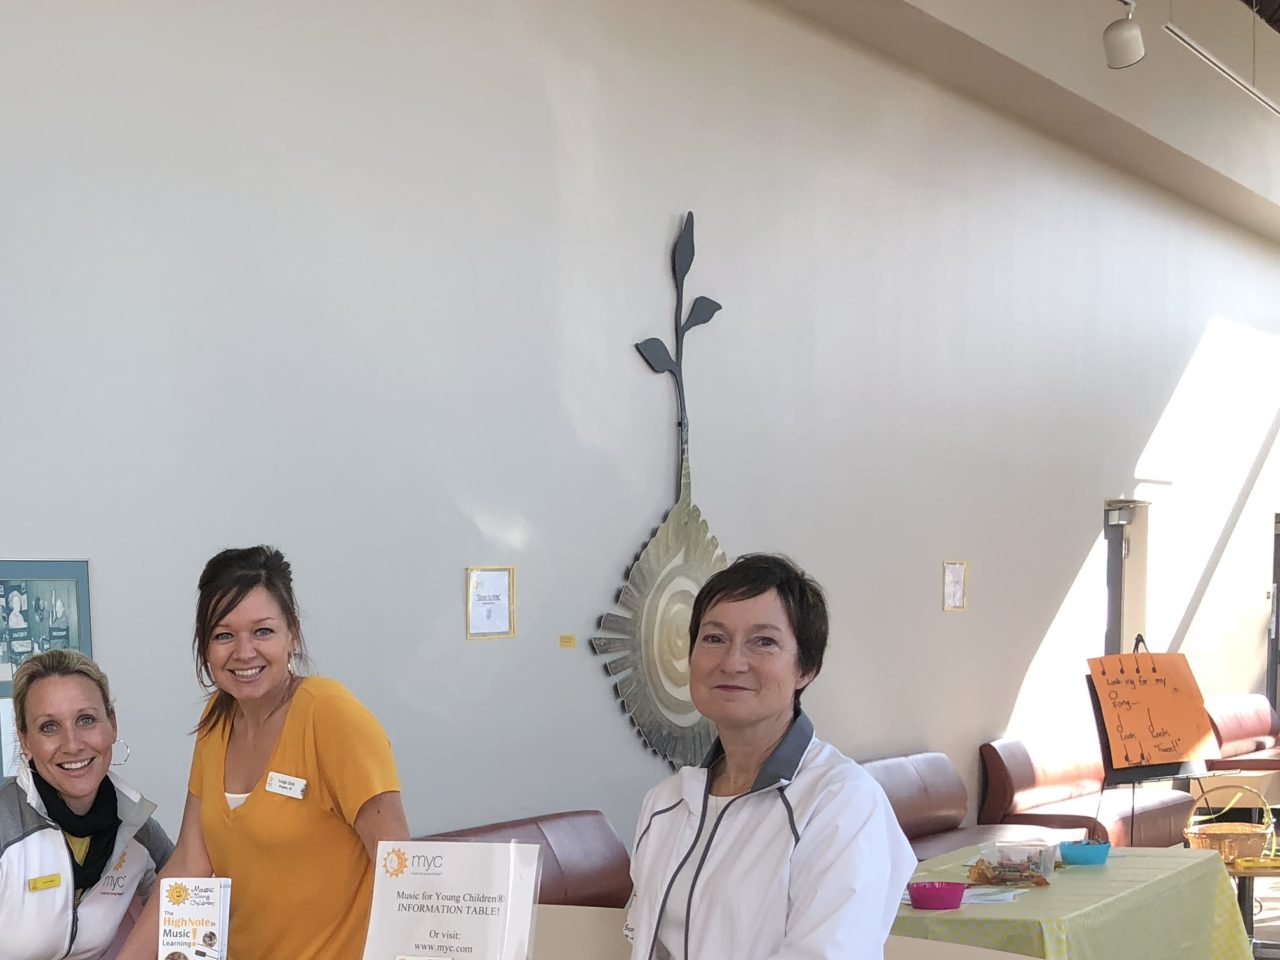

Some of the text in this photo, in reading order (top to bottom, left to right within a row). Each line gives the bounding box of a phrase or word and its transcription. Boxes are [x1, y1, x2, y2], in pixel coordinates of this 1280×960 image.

[411, 854, 443, 871] myc
[103, 875, 125, 890] myc
[396, 891, 419, 900] Music
[422, 891, 433, 900] for
[435, 892, 461, 903] Young
[397, 903, 500, 916] INFORMATION TABLE!
[163, 928, 191, 938] Music
[429, 929, 461, 940] Or visit:
[162, 940, 192, 948] Learning
[414, 942, 473, 954] www.myc.com
